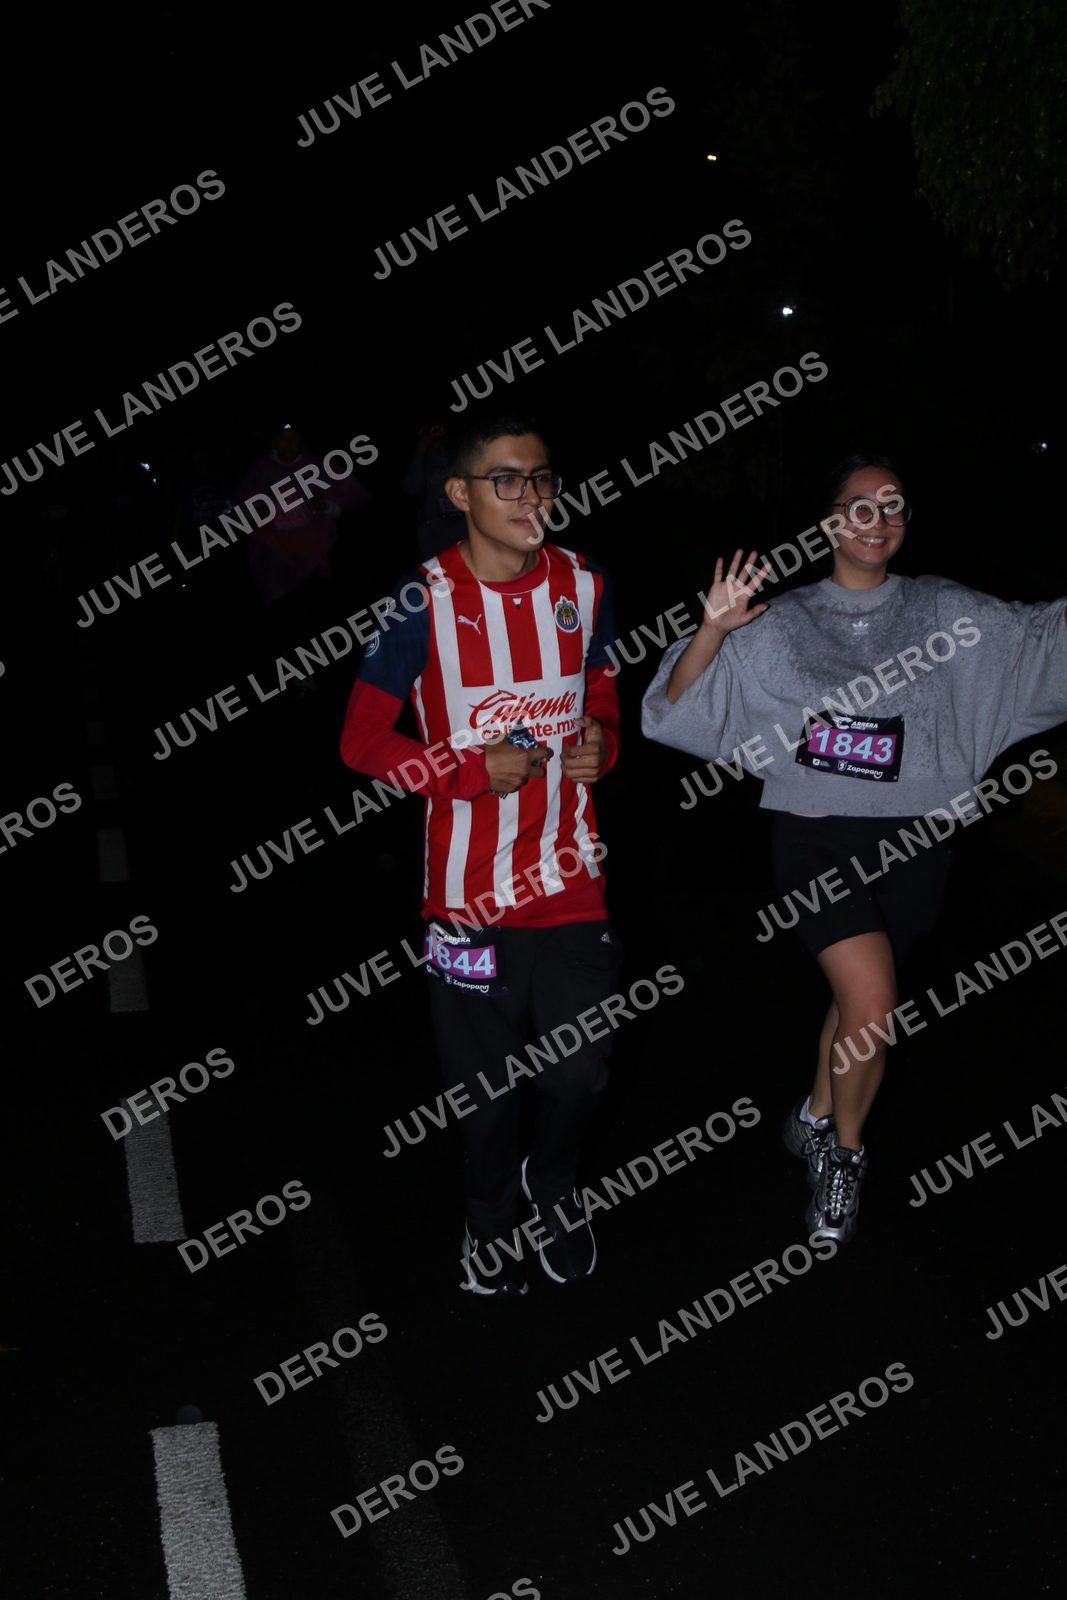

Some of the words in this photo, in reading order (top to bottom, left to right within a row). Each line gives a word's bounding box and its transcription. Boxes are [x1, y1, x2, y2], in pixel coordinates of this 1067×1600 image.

[468, 690, 577, 729] Caliente
[482, 717, 576, 740] calinte.mx
[815, 729, 893, 763] 1843
[425, 935, 494, 975] 1844
